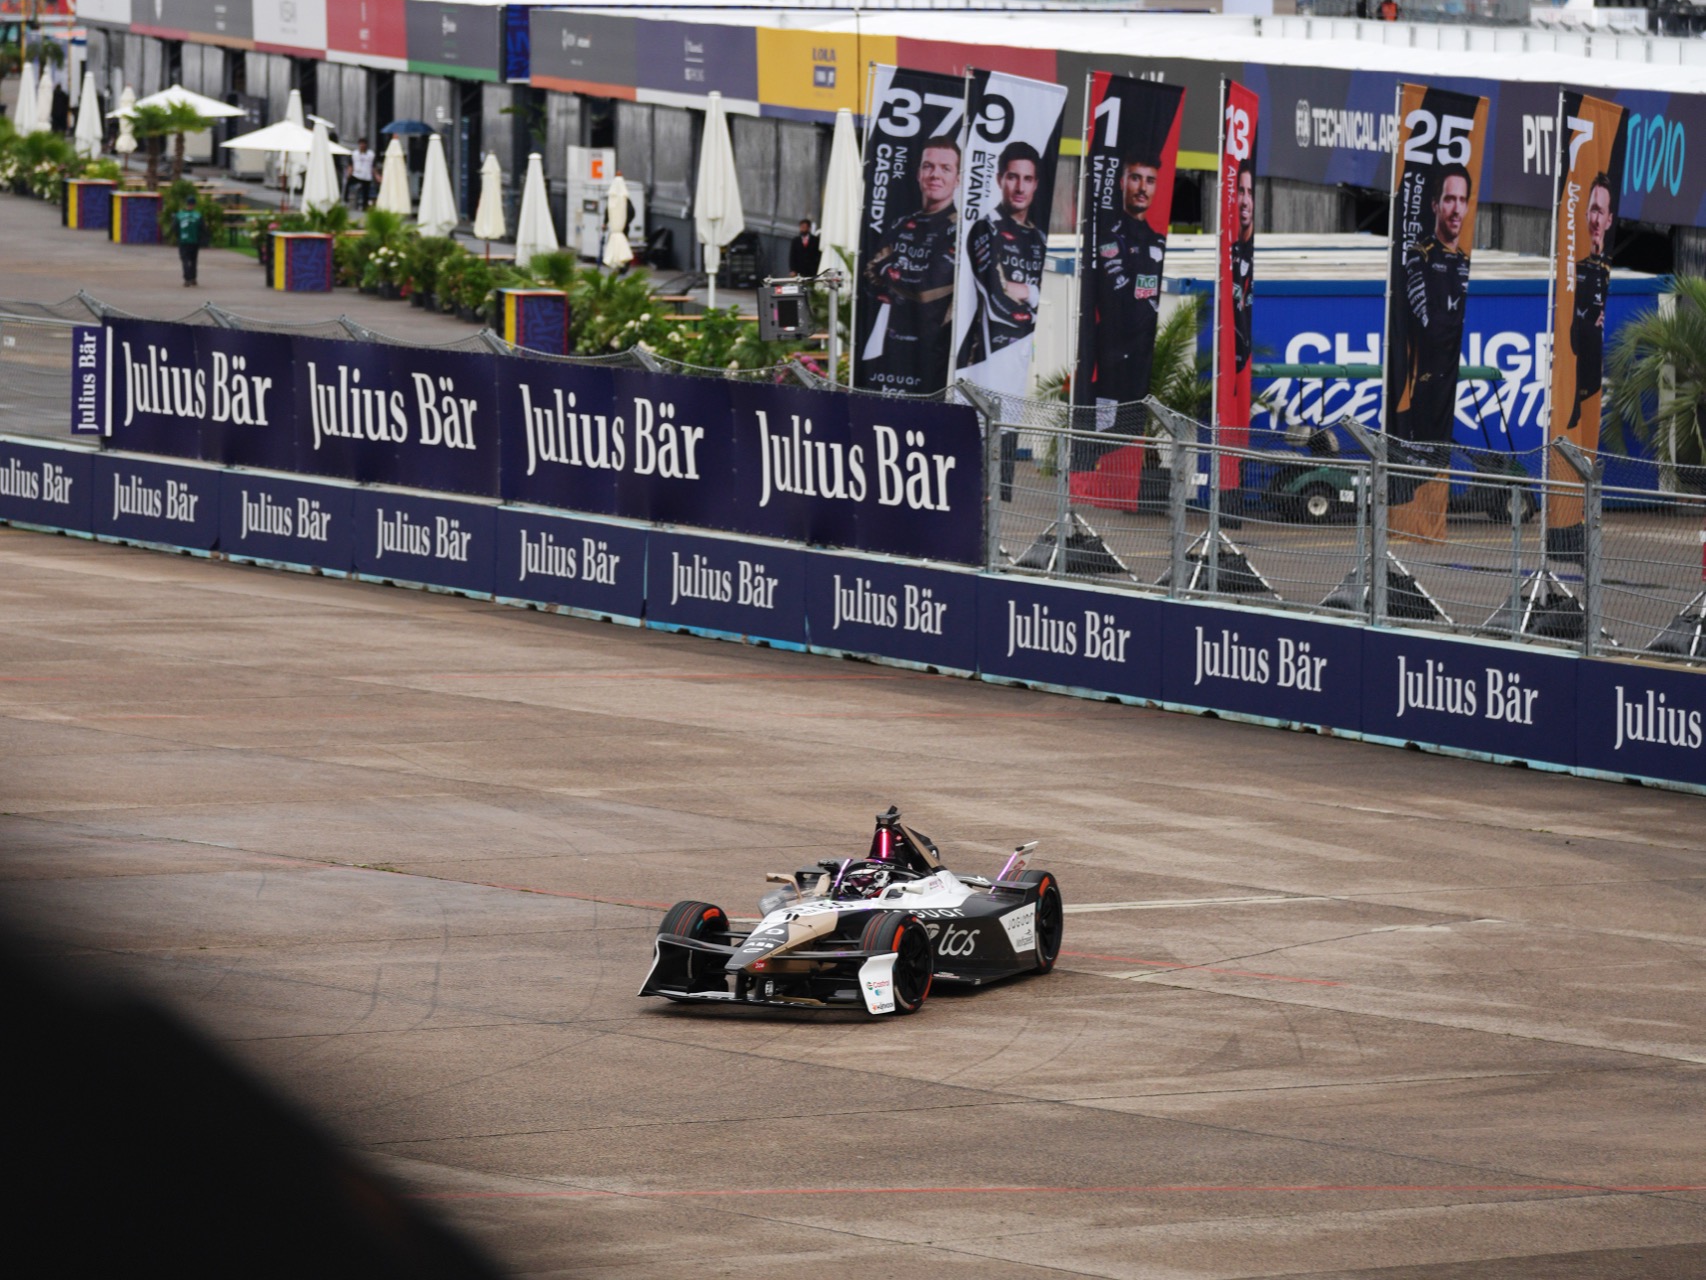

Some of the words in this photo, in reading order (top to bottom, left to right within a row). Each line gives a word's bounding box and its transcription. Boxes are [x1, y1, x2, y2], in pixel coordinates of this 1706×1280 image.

[812, 48, 837, 62] LOLA
[877, 87, 965, 139] 37
[975, 93, 1015, 143] 9
[1094, 96, 1121, 148] 1
[1225, 104, 1249, 162] 13
[1312, 107, 1377, 151] TECHNICAL
[1378, 114, 1400, 153] AR
[1404, 109, 1474, 167] 25
[892, 145, 908, 180] Nick
[1522, 114, 1553, 176] PIT
[1567, 115, 1594, 172] 7
[1623, 113, 1685, 197] TUDIO
[869, 143, 893, 234] CASSIDY
[964, 150, 986, 221] EVANS
[983, 153, 996, 199] Mitch
[1101, 156, 1120, 210] Pascal
[78, 331, 97, 368] Bär
[77, 373, 99, 431] Julius
[123, 342, 206, 426] Julius
[212, 352, 271, 425] Bär
[308, 362, 407, 449] Julius
[412, 373, 477, 449] Bär
[519, 384, 625, 475] Julius
[634, 398, 703, 479] Bär
[0, 458, 38, 499] ulius
[43, 463, 72, 503] Bär
[756, 411, 866, 507] Julius
[873, 425, 955, 511] Bär
[113, 473, 161, 520] Julius
[166, 480, 198, 522] Bär
[242, 491, 292, 539] Julius
[297, 498, 331, 541] Bär
[376, 509, 430, 558] Julius
[435, 517, 471, 561] Bär
[520, 530, 576, 581] Julius
[582, 538, 619, 584] Bär
[671, 552, 731, 605] Julius
[738, 561, 778, 608] Bär
[833, 575, 897, 629] Julius
[904, 585, 946, 634] Bär
[1008, 601, 1076, 657] Julius
[1084, 611, 1131, 663] Bär
[1195, 627, 1269, 685] Julius
[1277, 638, 1327, 691] Bär
[1397, 656, 1476, 717] Julius
[1485, 668, 1538, 724] Bär
[1615, 686, 1702, 749] Julius
[938, 923, 980, 956] tcs
